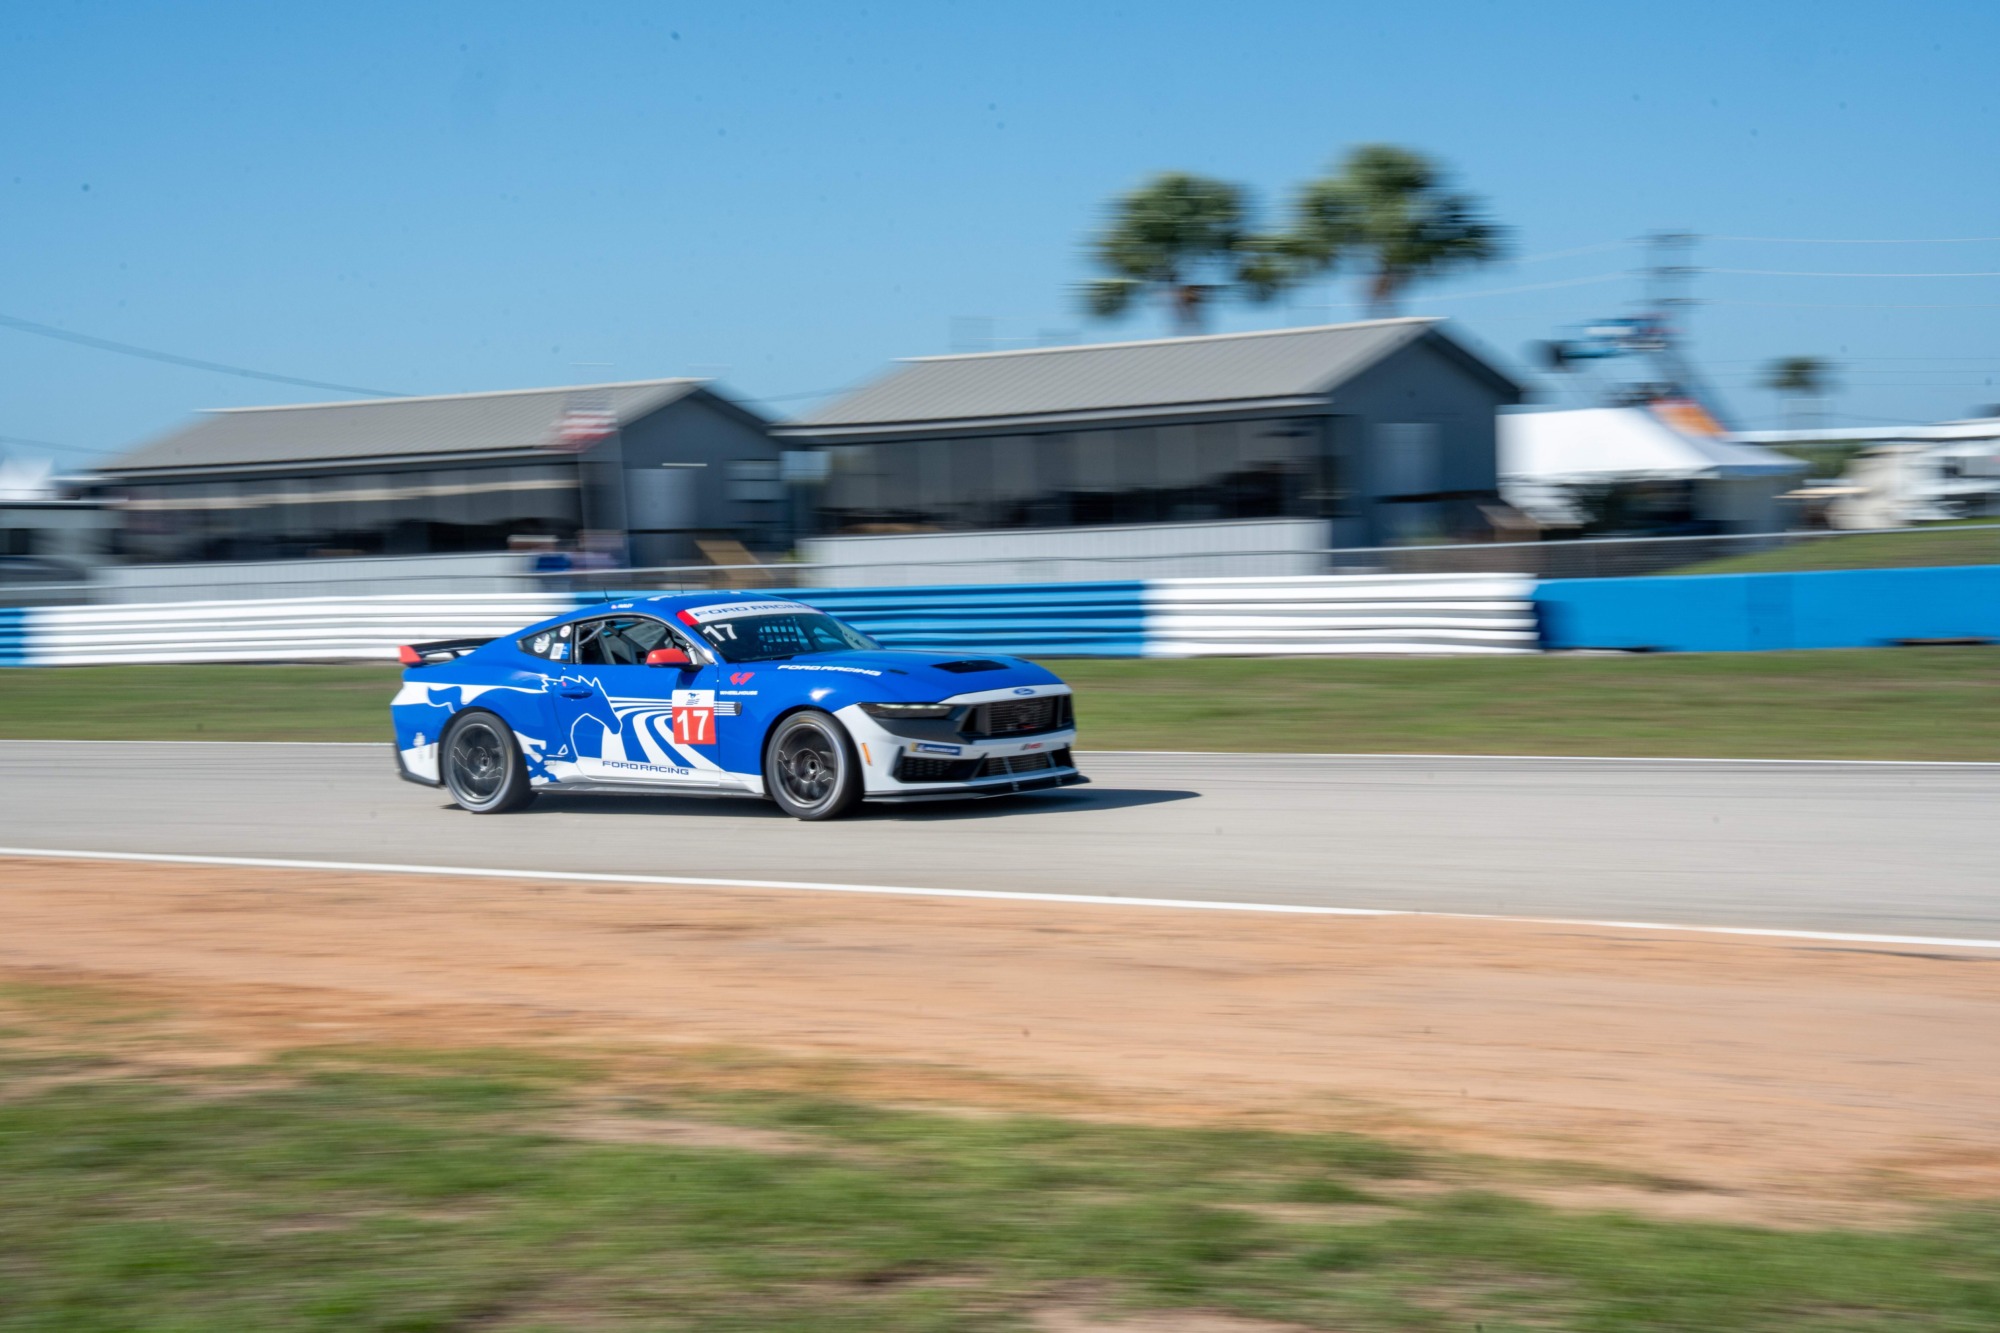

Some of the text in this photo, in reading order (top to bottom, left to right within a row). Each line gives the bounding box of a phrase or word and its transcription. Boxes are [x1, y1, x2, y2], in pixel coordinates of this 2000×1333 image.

[694, 605, 748, 617] FORD
[703, 623, 738, 642] 17
[820, 665, 883, 677] RACING
[676, 709, 709, 741] 17
[602, 760, 690, 776] FORD RACING
